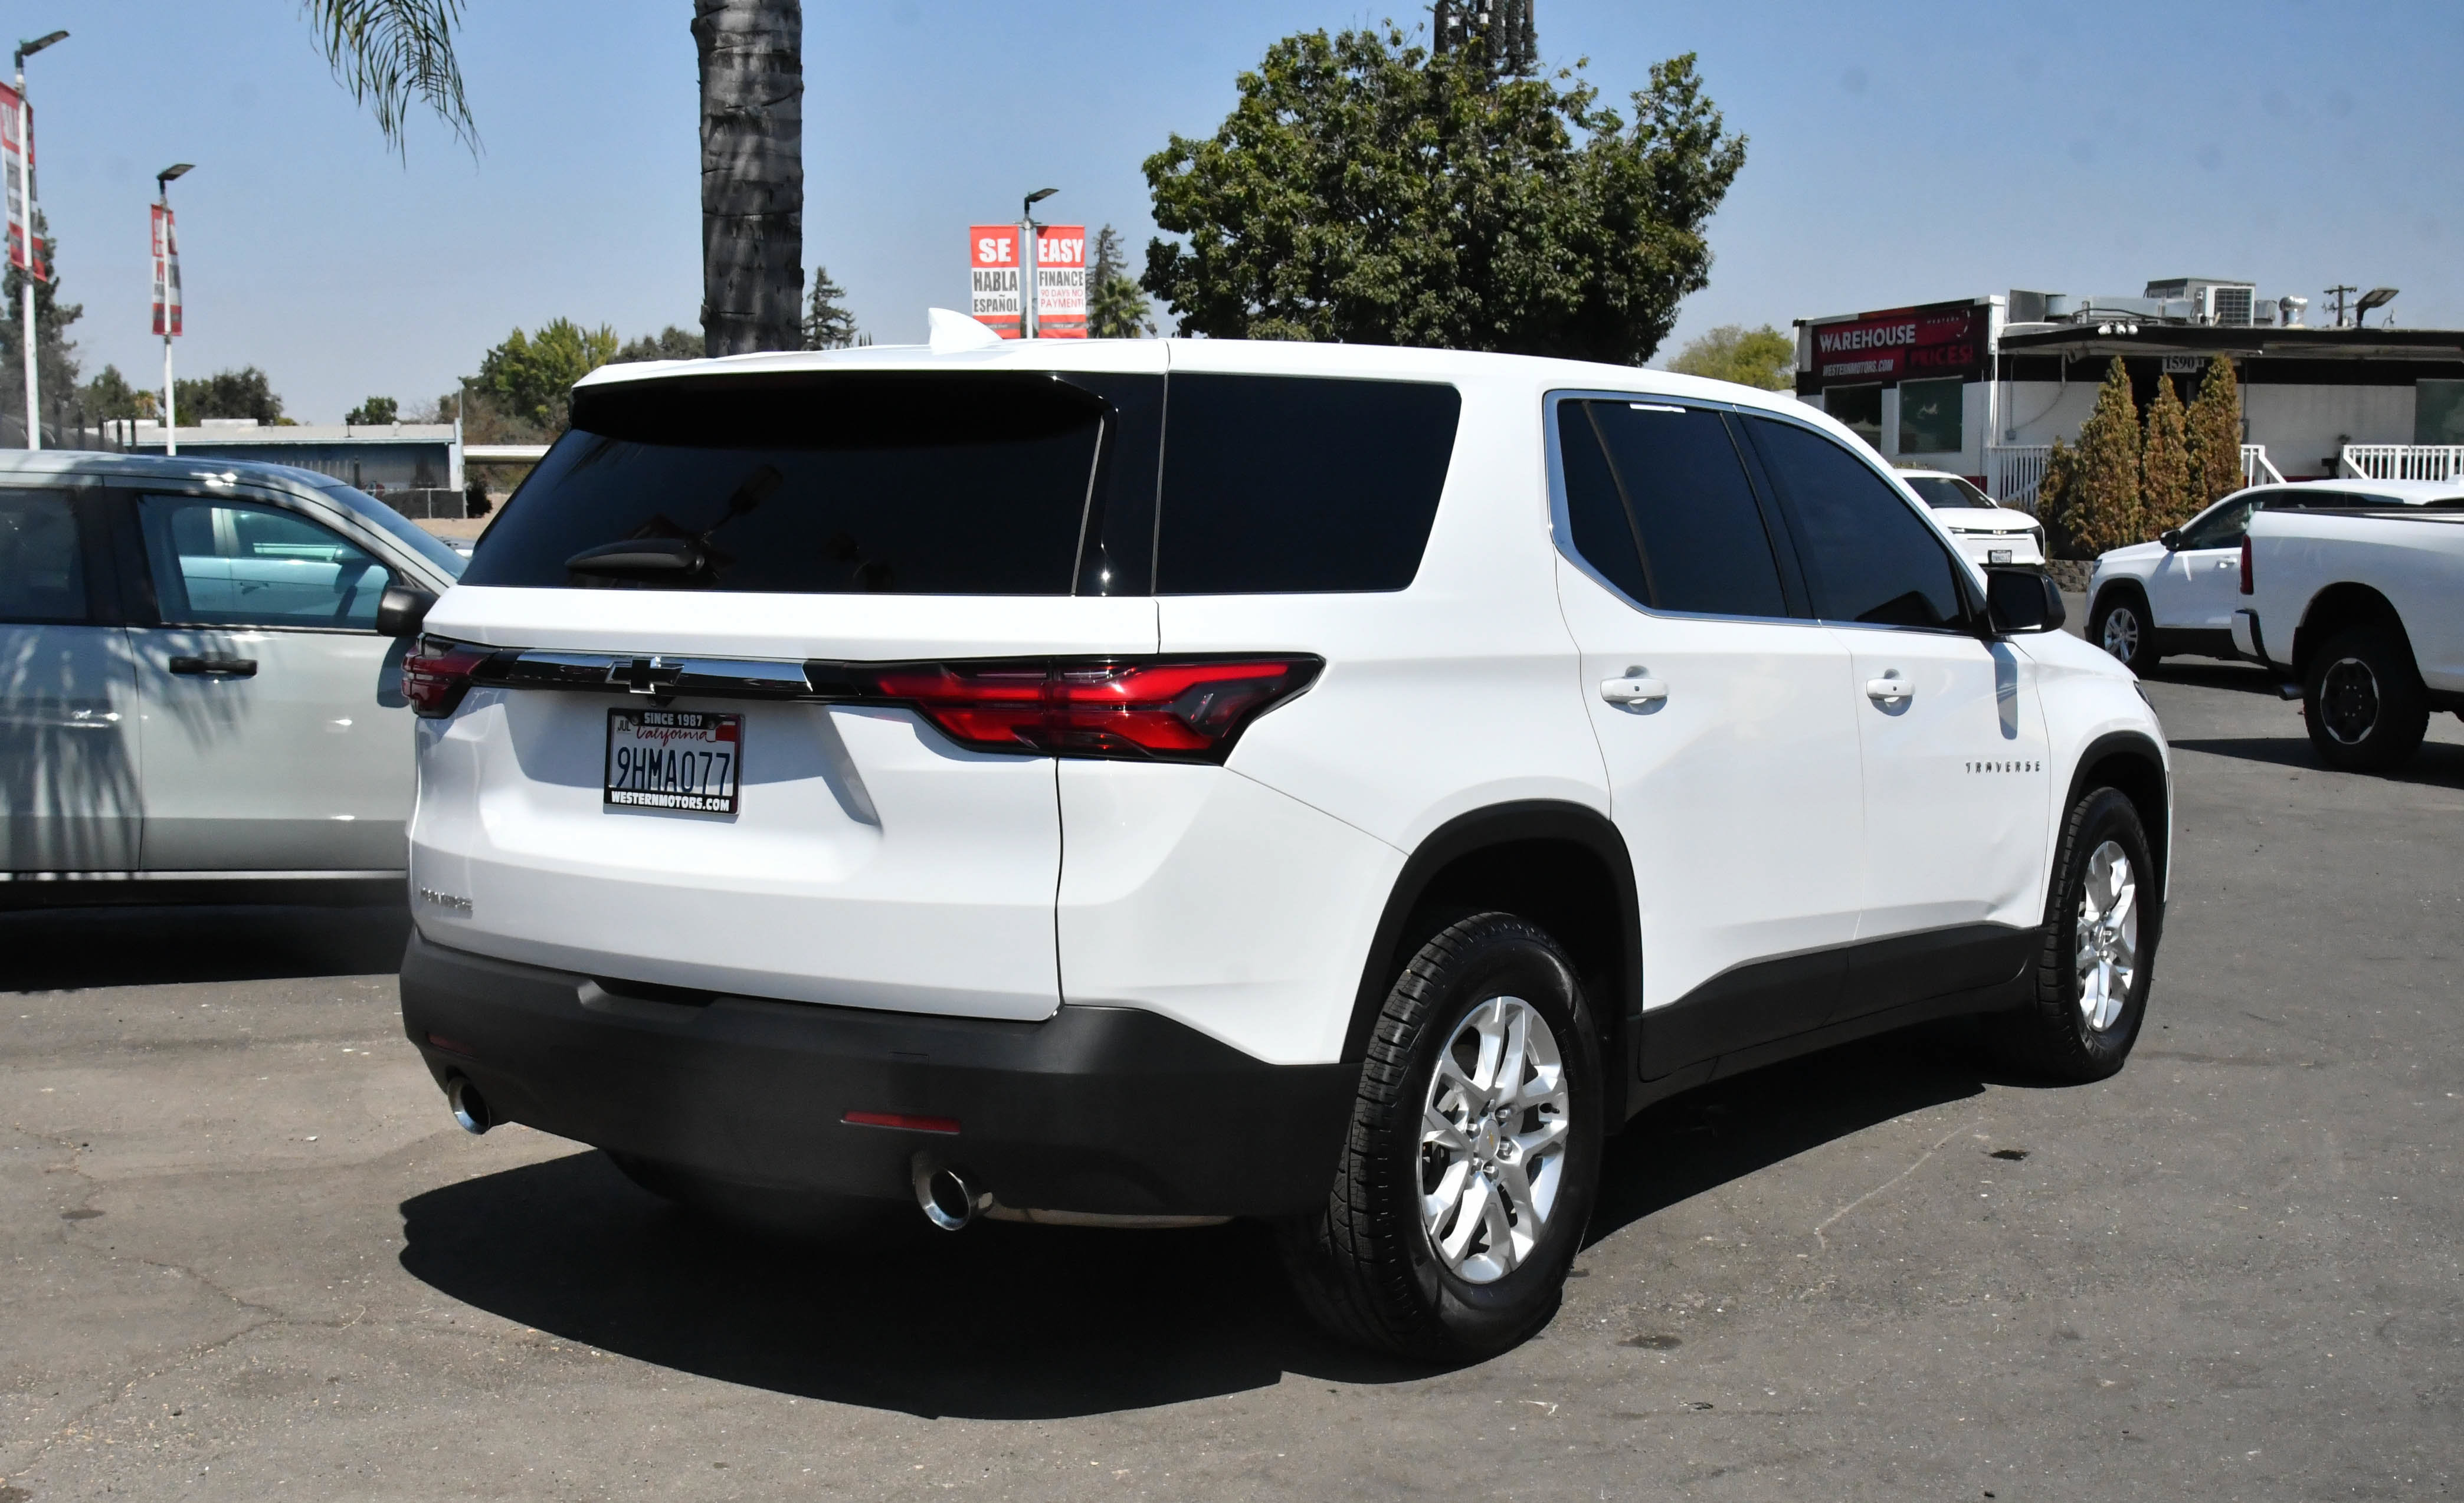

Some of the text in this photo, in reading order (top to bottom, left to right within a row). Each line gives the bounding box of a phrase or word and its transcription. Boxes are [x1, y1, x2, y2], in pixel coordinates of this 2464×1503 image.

[978, 238, 1011, 262] SE
[1038, 238, 1084, 262] EASY
[973, 271, 1018, 291] HABLA
[1038, 271, 1083, 286] FINANCE
[974, 294, 1018, 312] ESPAÑOL
[1819, 324, 1916, 353] WAREHOUSE
[1823, 359, 1893, 378] WESTERNMOTORS.COM
[2166, 355, 2195, 369] 1590
[618, 719, 631, 731] JUL
[644, 712, 702, 727] SINCE 1987
[636, 726, 716, 747] California
[616, 747, 730, 796] 9HMA077
[1965, 761, 2040, 774] TRAVERSE
[611, 790, 729, 811] WESTERNMOTORS.COM
